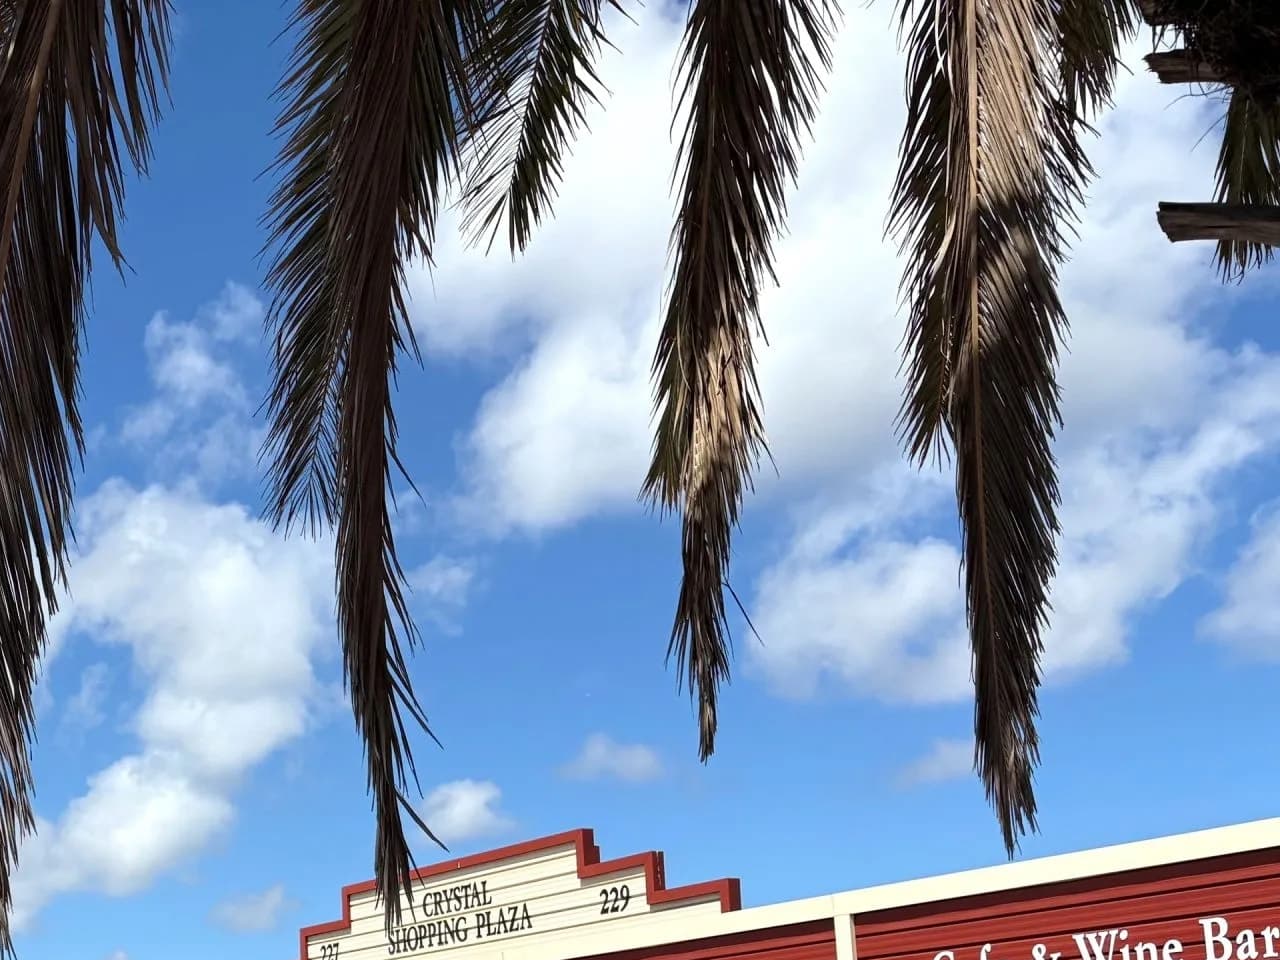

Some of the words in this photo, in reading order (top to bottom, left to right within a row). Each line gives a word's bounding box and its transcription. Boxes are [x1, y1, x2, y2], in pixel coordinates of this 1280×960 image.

[423, 880, 492, 917] CRYSTAL
[600, 884, 630, 914] 229
[388, 916, 468, 955] SHOPPING
[476, 903, 533, 938] PLAZA
